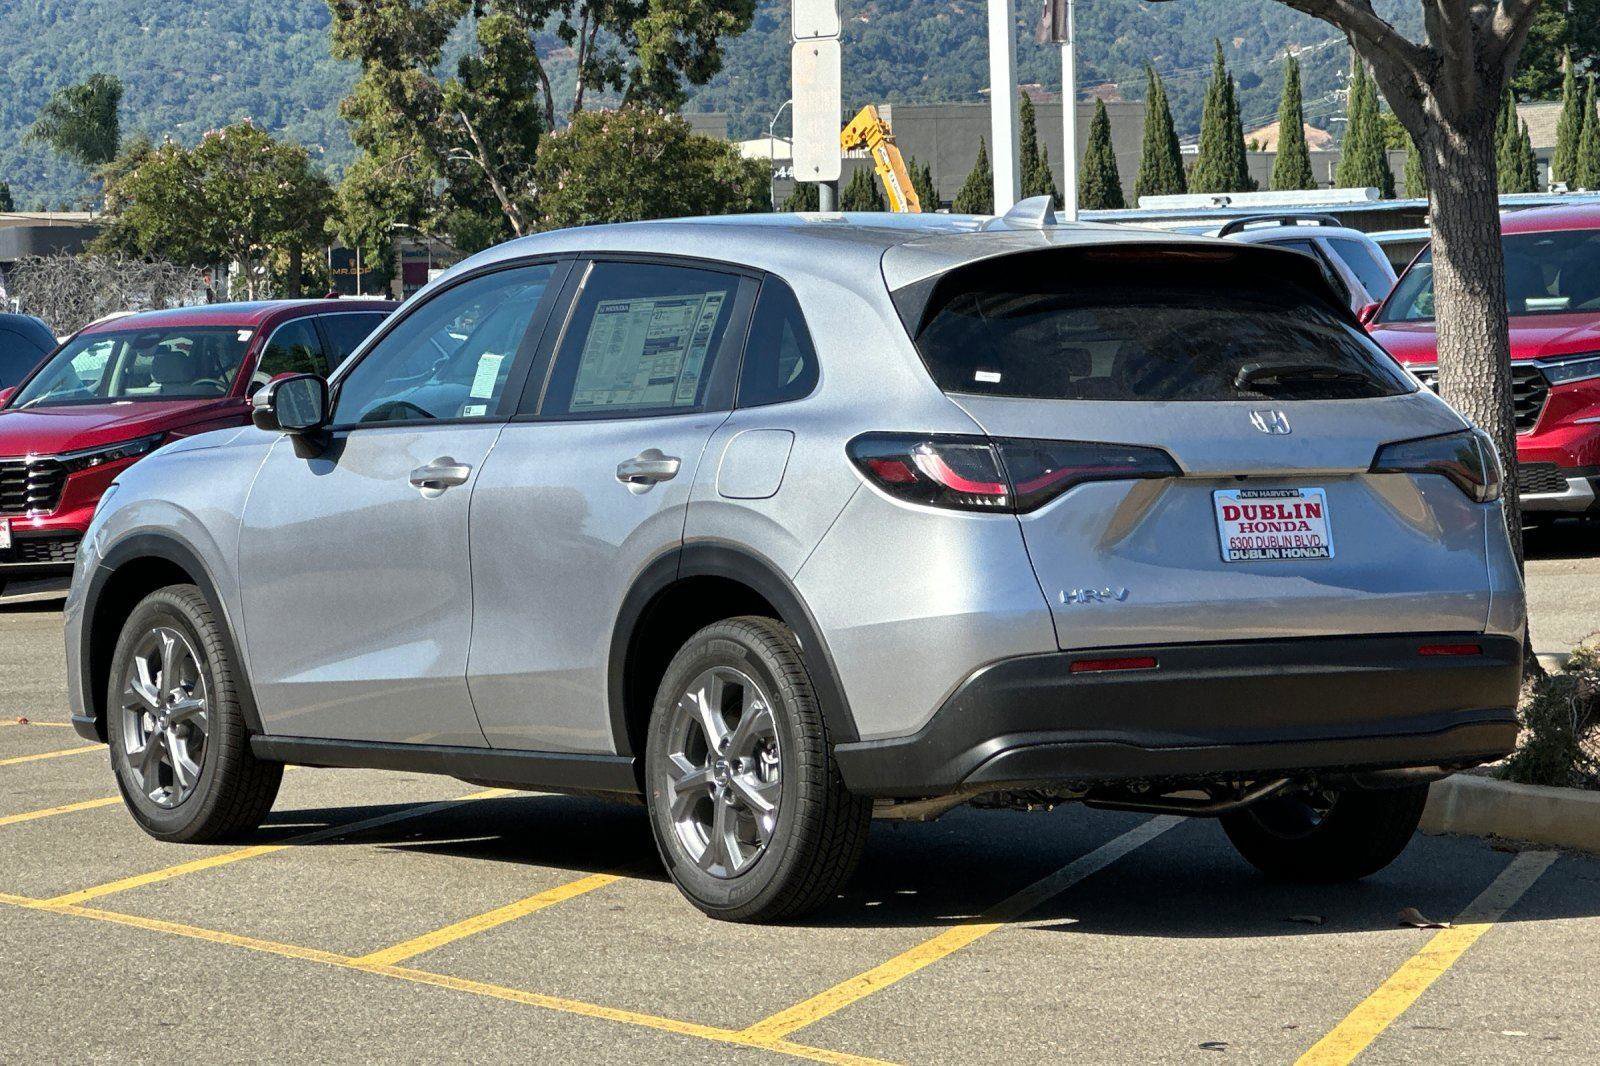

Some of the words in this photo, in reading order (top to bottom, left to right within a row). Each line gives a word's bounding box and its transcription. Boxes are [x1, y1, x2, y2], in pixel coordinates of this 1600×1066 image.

[1241, 490, 1259, 498] KEN
[1259, 489, 1299, 498] HARVEY'S
[1222, 503, 1322, 521] DUBLIN
[1238, 521, 1312, 533] HONDA
[1230, 536, 1254, 549] 6300
[1255, 535, 1293, 549] DUBLIN
[1294, 534, 1324, 548] BLVD.
[1230, 549, 1280, 560] DUBLIN
[1282, 547, 1329, 559] HONDA
